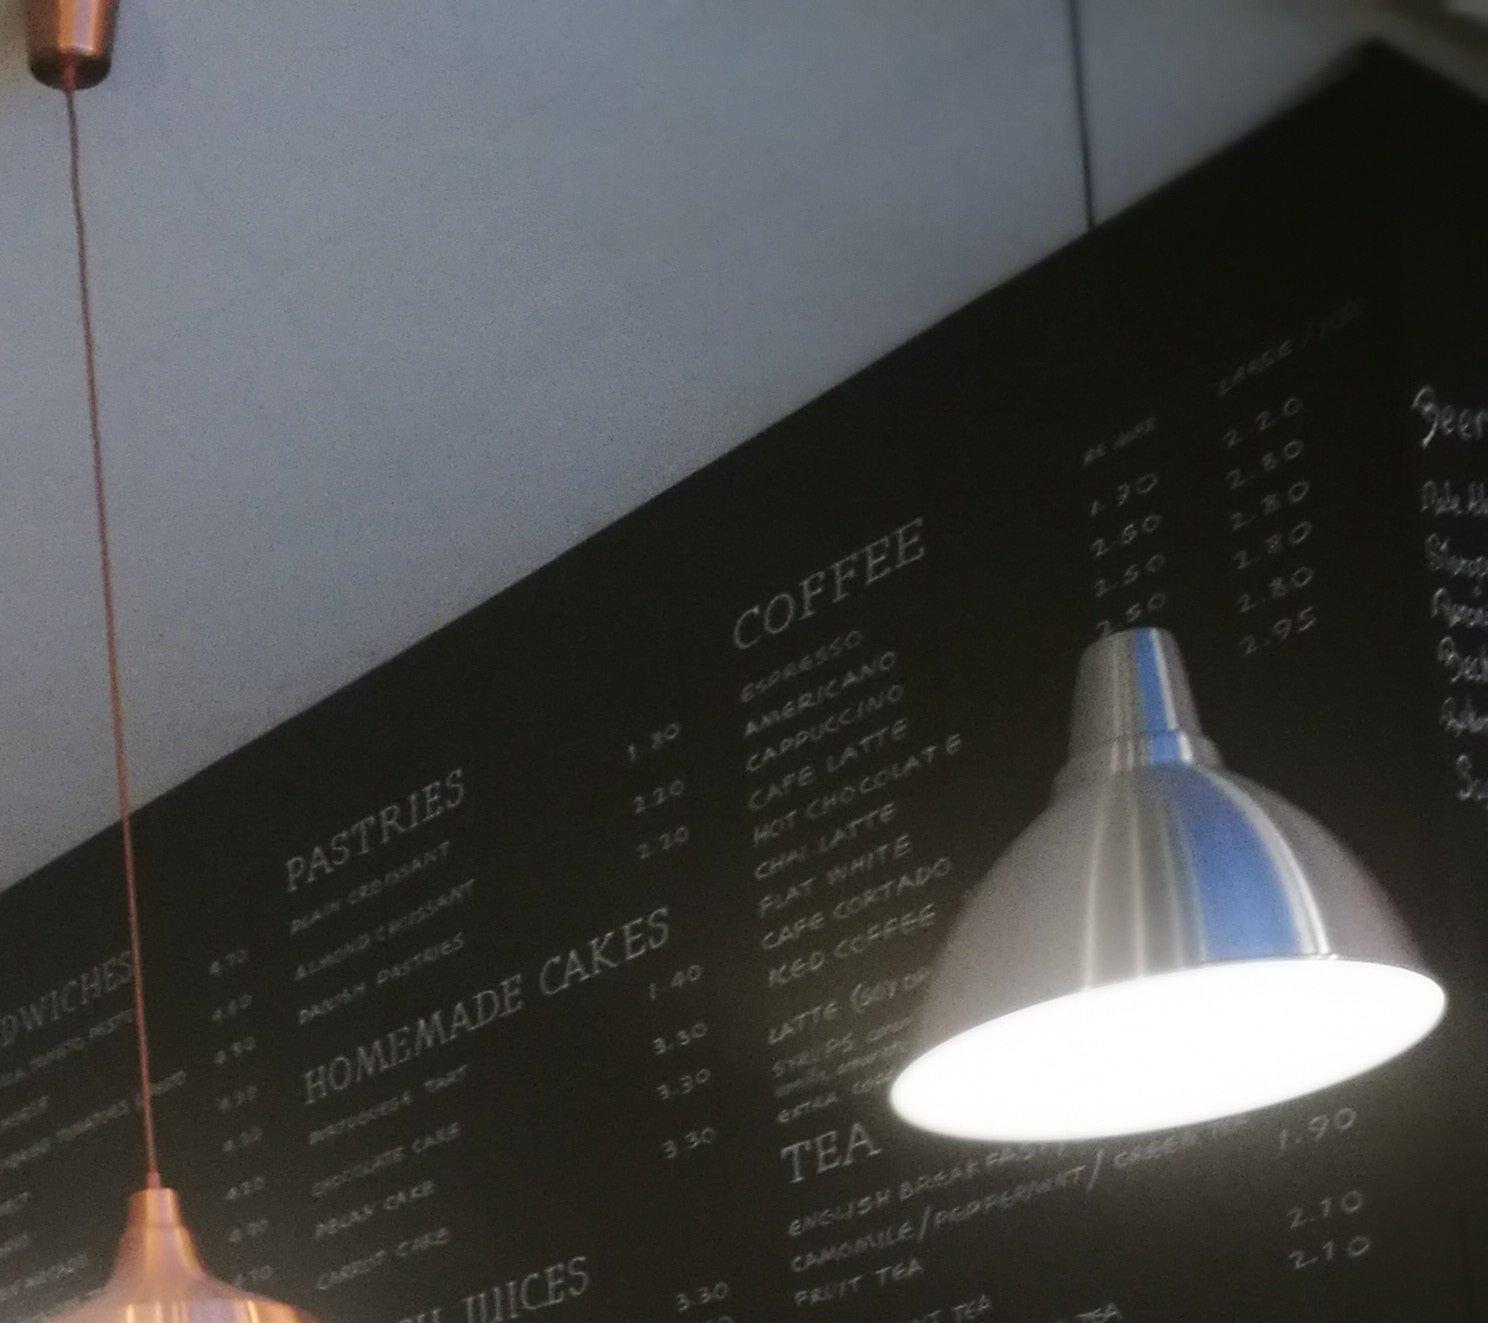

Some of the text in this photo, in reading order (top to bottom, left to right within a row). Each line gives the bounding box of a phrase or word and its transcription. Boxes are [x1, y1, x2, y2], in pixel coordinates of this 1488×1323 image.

[1090, 513, 1162, 559] 2.50
[733, 516, 925, 649] COFFEE
[1094, 552, 1166, 598] 2.50
[740, 630, 863, 703] ESPRESSO
[743, 651, 897, 738] AMERICANO
[746, 684, 904, 773] CAPPUCCINO
[747, 717, 908, 811] CAFE LATTE
[753, 732, 963, 847] HOT CHOCOLATE
[285, 767, 467, 893] PASTRIES
[753, 802, 896, 881] CHAI LATTE
[759, 833, 910, 918] FLAT WHITE
[761, 856, 952, 950] CAFE CORTADO
[294, 933, 371, 982] ALMOND
[376, 931, 466, 986] PASTRIES
[768, 902, 936, 988] ICED COFFEE
[302, 905, 671, 1107] HOMEMADE CAKES
[648, 964, 703, 1001] 1.40
[768, 1001, 838, 1045] LATTE
[411, 1120, 461, 1155] CAKE
[662, 1126, 718, 1160] 3.30
[780, 1122, 882, 1184] TEA
[1279, 1107, 1357, 1152] 1.90
[383, 1178, 437, 1212] CAKE
[787, 1187, 891, 1238] ENGLISH
[1286, 1189, 1365, 1230] 2.10
[394, 1226, 452, 1258] CAKE
[1288, 1234, 1372, 1271] 2.10
[675, 1280, 730, 1313] 3.30
[794, 1257, 924, 1308] FRUIT TEA
[951, 1293, 993, 1323] TEA
